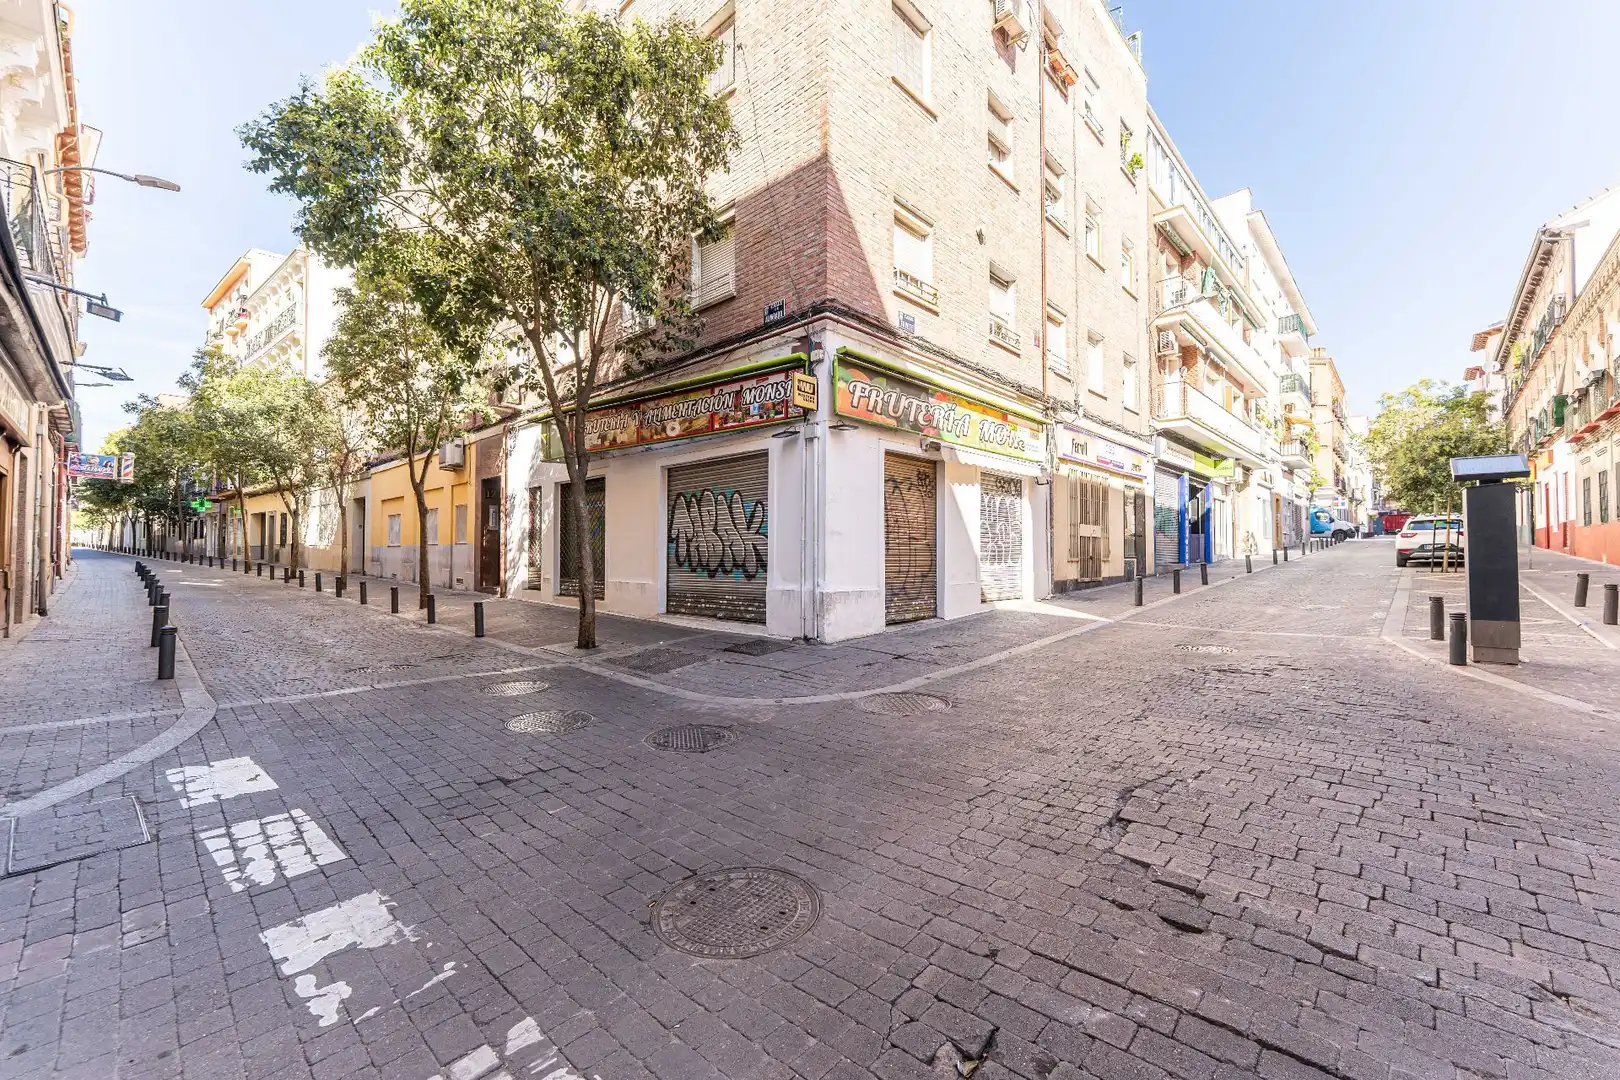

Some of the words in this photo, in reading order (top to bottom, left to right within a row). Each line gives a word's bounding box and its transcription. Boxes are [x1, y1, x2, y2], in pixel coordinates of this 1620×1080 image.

[584, 409, 630, 435] RUTERÍA
[643, 388, 734, 426] ALIMENTACIÓN
[848, 379, 971, 438] FRUTERÍA
